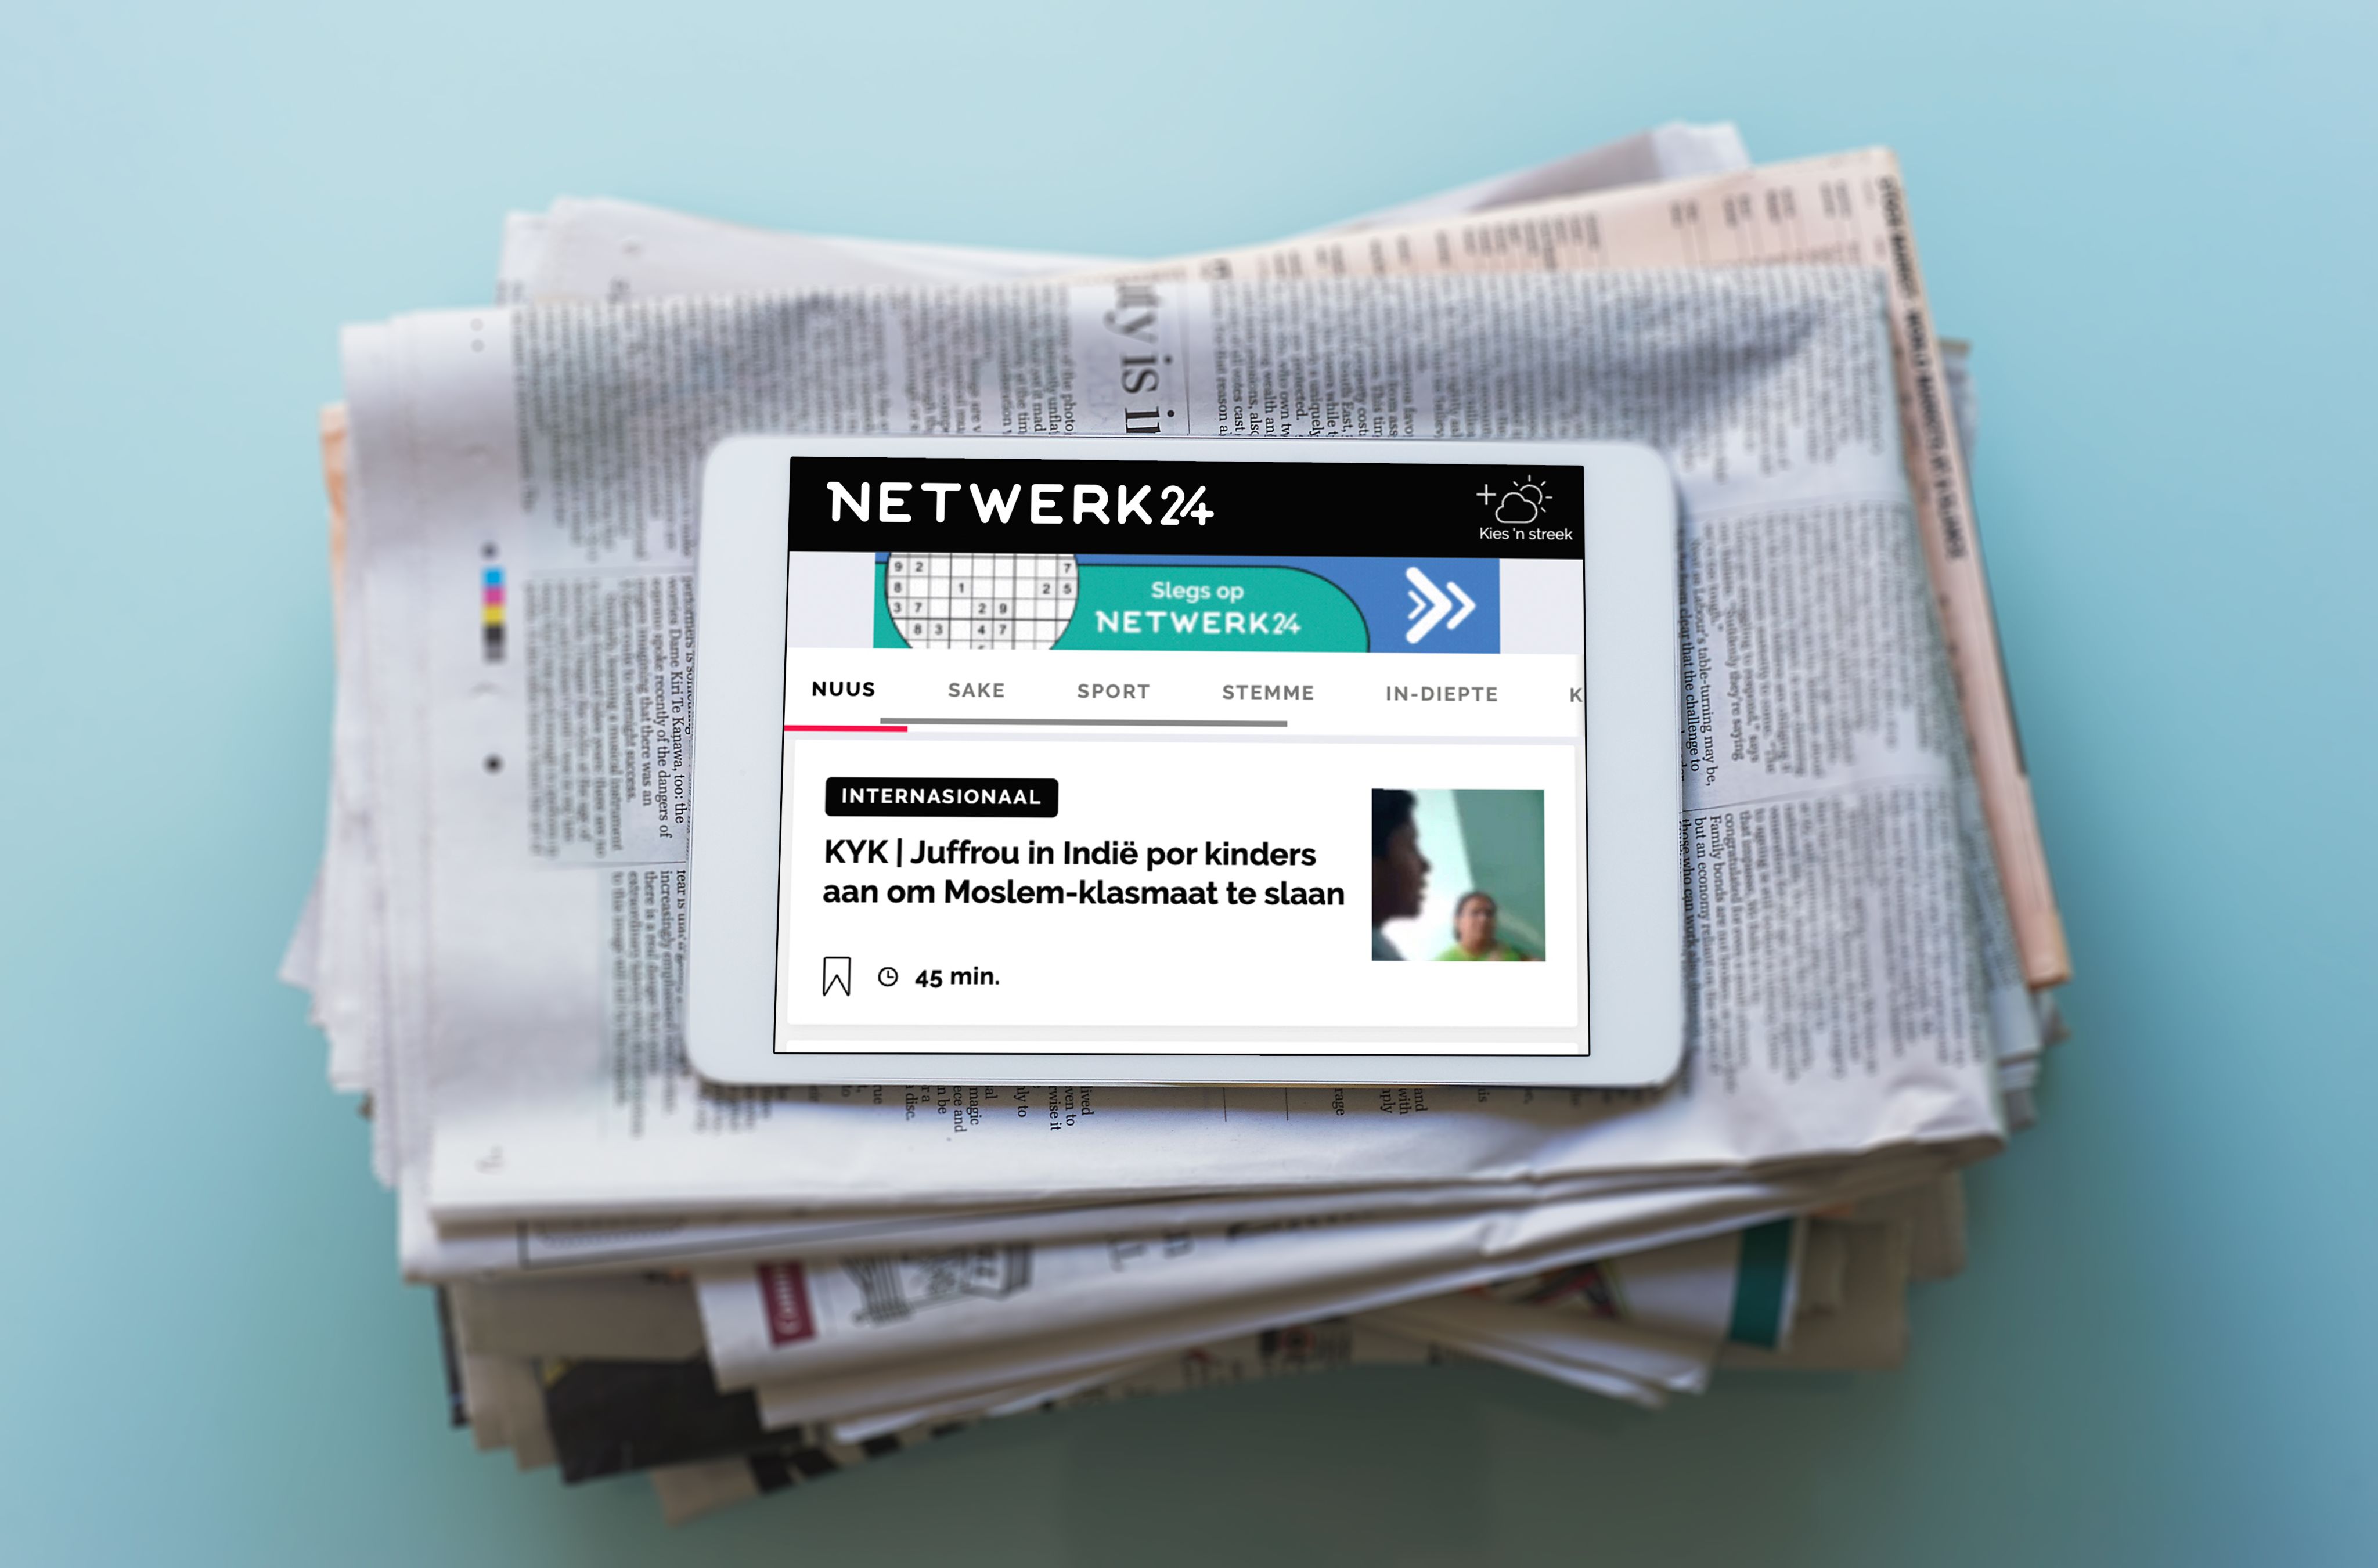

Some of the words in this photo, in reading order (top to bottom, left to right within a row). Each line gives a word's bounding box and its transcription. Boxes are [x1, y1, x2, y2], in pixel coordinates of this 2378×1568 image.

[1120, 354, 1173, 394] is
[1217, 378, 1228, 421] reason
[1263, 372, 1277, 414] wealth
[1280, 391, 1289, 419] own
[1060, 394, 1076, 435] photo
[1234, 406, 1245, 431] cast
[1308, 380, 1324, 436] uniquely
[1327, 391, 1339, 428] while
[1342, 401, 1353, 432] East,
[1264, 417, 1277, 436] an
[827, 482, 1214, 525] NETWERK24
[1480, 527, 1509, 540] Kies
[1512, 527, 1525, 540] 'n
[1529, 527, 1573, 540] streek
[895, 562, 903, 572] 9
[916, 562, 923, 572] 2
[1064, 564, 1071, 573] 7
[894, 582, 902, 593] 8
[959, 583, 965, 593] 1
[1043, 584, 1050, 594] 2
[1151, 581, 1211, 603] Slegs
[1216, 586, 1244, 603] op
[915, 603, 922, 613] 7
[978, 603, 986, 614] 2
[1000, 603, 1007, 614] 9
[1693, 588, 1710, 644] Labour's
[935, 624, 943, 635] 3
[978, 625, 985, 635] 4
[1000, 625, 1007, 635] 7
[1095, 610, 1301, 635] NETWERK24
[1678, 608, 1692, 640] clear
[669, 629, 682, 667] Dame
[1681, 643, 1695, 667] that
[671, 671, 683, 694] Kiri
[813, 682, 874, 697] NUUS
[949, 683, 1004, 697] SAKE
[1078, 684, 1149, 698] SPORT
[1223, 685, 1313, 700] STEMME
[1388, 687, 1497, 701] IN-DIEPTE
[1571, 688, 1582, 702] K
[1683, 671, 1696, 690] the
[1697, 648, 1714, 733] table-turning
[641, 697, 653, 722] that
[653, 675, 670, 726] recently
[672, 697, 684, 713] Te
[657, 730, 669, 743] of
[1685, 694, 1700, 755] challenge
[642, 726, 654, 758] there
[670, 717, 684, 772] Kanawa,
[1702, 736, 1714, 763] may
[1730, 719, 1745, 761] saying
[658, 747, 670, 766] the
[1691, 759, 1701, 772] to
[625, 749, 636, 803] success.
[642, 763, 652, 786] was
[673, 774, 685, 799] too:
[1706, 766, 1718, 786] be,
[642, 790, 653, 806] an
[655, 770, 671, 821] dangers
[842, 788, 1040, 804] INTERNASIONAAL
[675, 803, 687, 823] the
[660, 824, 672, 838] of
[1682, 818, 1692, 855] those
[1694, 817, 1707, 839] but
[1709, 815, 1725, 859] Family
[826, 840, 888, 863] KYK
[911, 839, 1019, 864] Juffrou
[1029, 841, 1053, 864] in
[1065, 841, 1138, 864] Indië
[1147, 848, 1197, 871] por
[1206, 842, 1316, 866] kinders
[1696, 842, 1706, 859] an
[1682, 857, 1695, 885] who
[1713, 862, 1728, 903] bonds
[644, 871, 658, 905] there
[823, 885, 877, 903] aan
[888, 885, 934, 903] om
[945, 879, 1218, 904] Moslem-klasmaat
[1227, 882, 1257, 905] te
[1265, 881, 1344, 905] slaan
[1682, 888, 1694, 911] can
[1698, 862, 1711, 921] economy
[658, 870, 676, 948] increasingly
[1716, 906, 1727, 925] are
[1685, 915, 1699, 949] work
[916, 970, 942, 987] 45
[951, 967, 999, 985] min.
[905, 1093, 918, 1122] disc.
[938, 1099, 950, 1115] be
[967, 1088, 981, 1125] magic
[1018, 1106, 1028, 1118] to
[1332, 1088, 1345, 1116] rage
[1398, 1088, 1412, 1115] with
[1415, 1088, 1428, 1112] and
[954, 1109, 967, 1133] and
[1051, 1122, 1062, 1131] it
[1066, 1114, 1076, 1126] to
